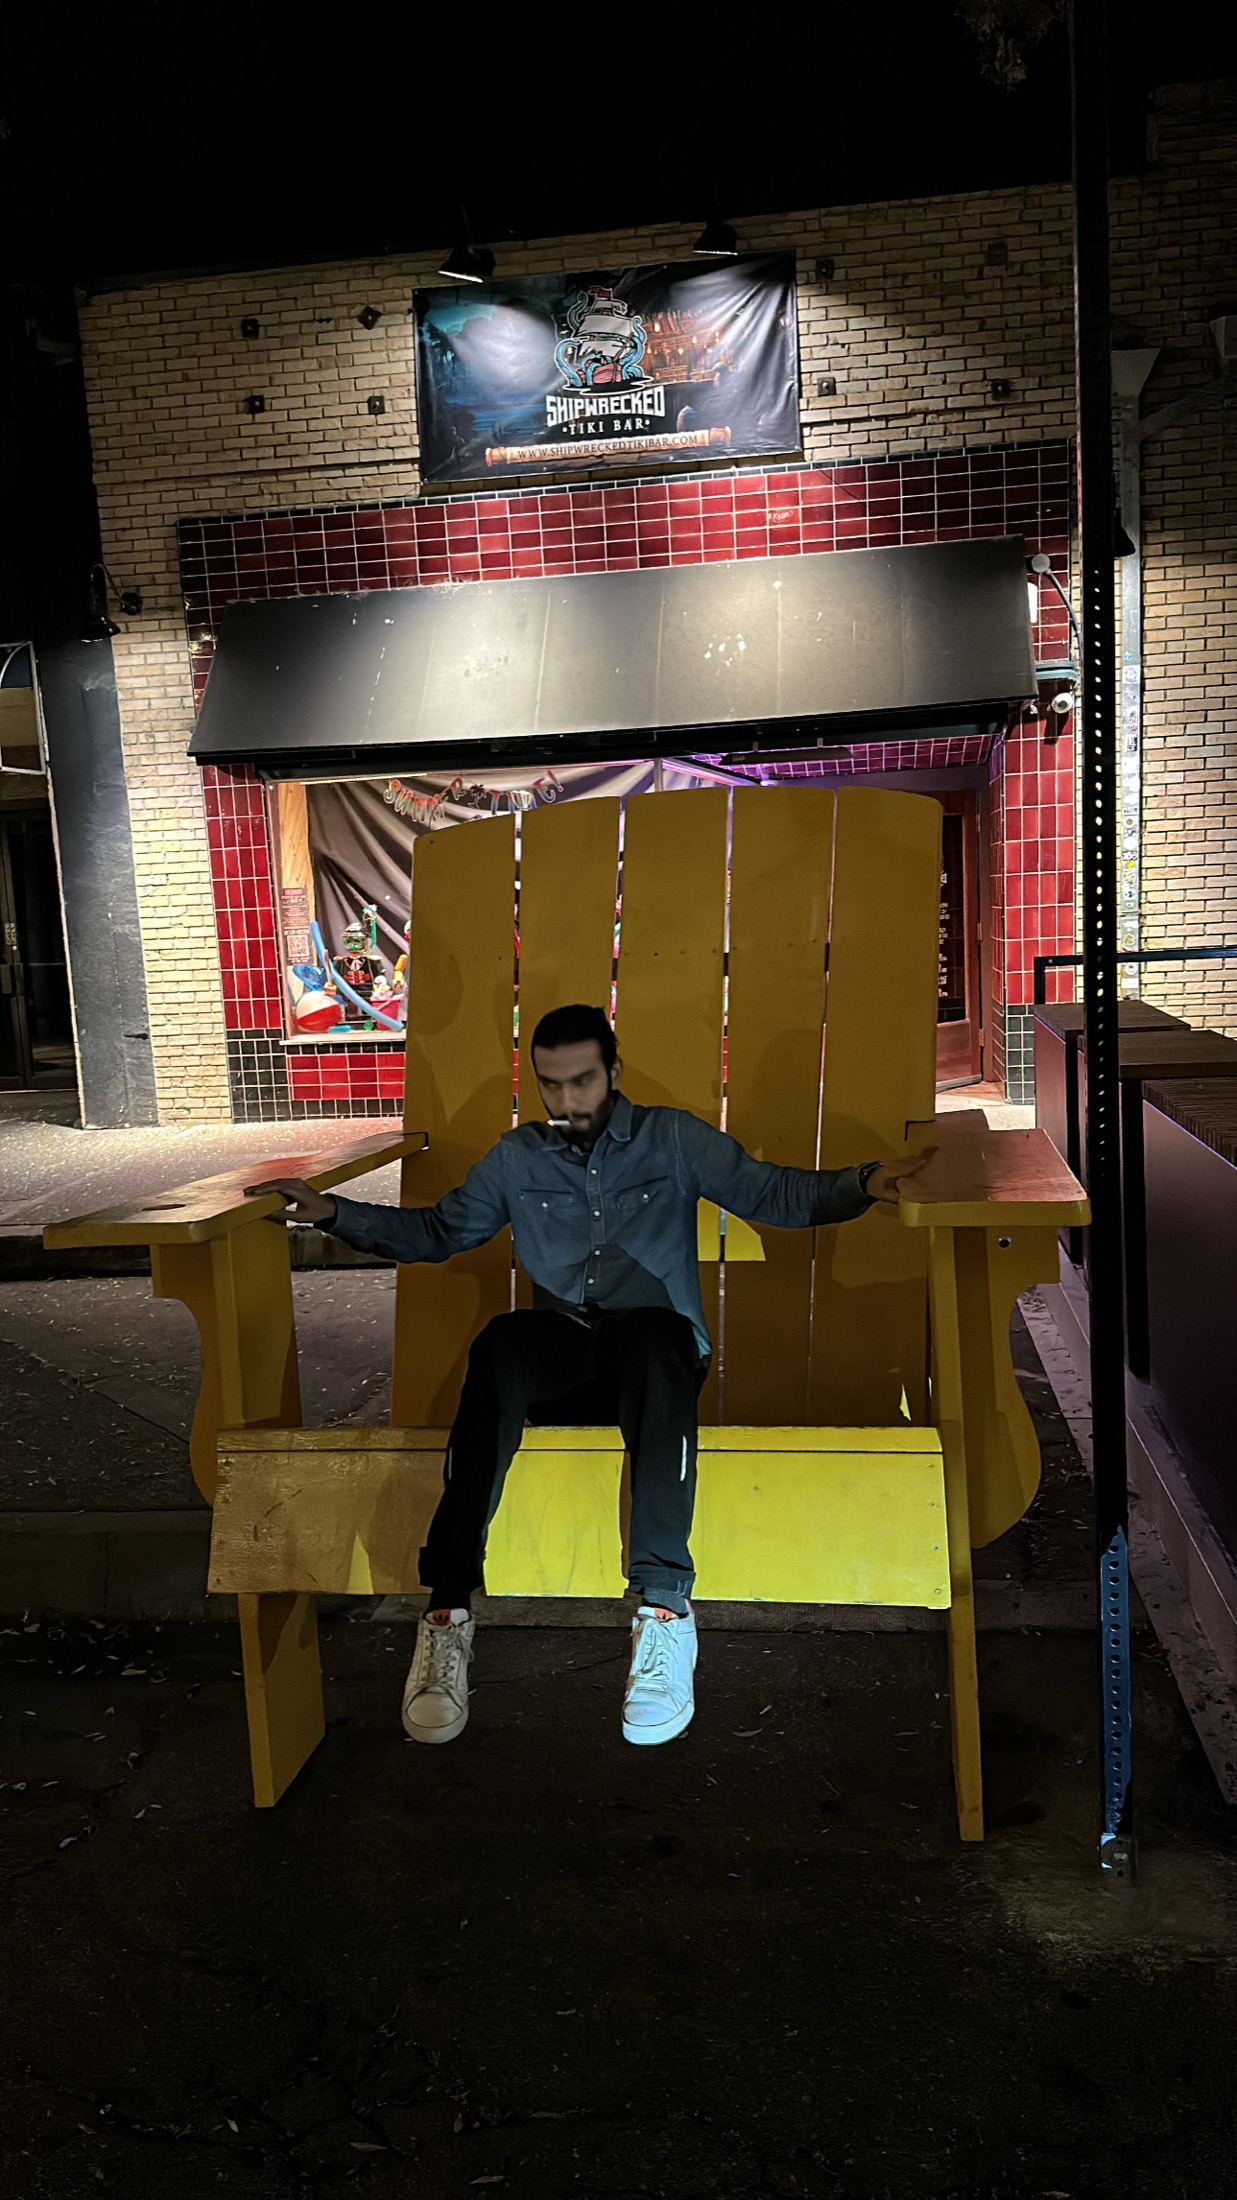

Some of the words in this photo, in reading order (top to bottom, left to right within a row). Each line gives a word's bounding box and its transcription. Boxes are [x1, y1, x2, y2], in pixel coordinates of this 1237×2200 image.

[546, 385, 665, 428] SHIPWRECKED
[568, 421, 605, 436] TIKI
[613, 417, 645, 433] BAR
[517, 435, 698, 459] WWW.SHIPWRECKEDTIKIBAR.COM
